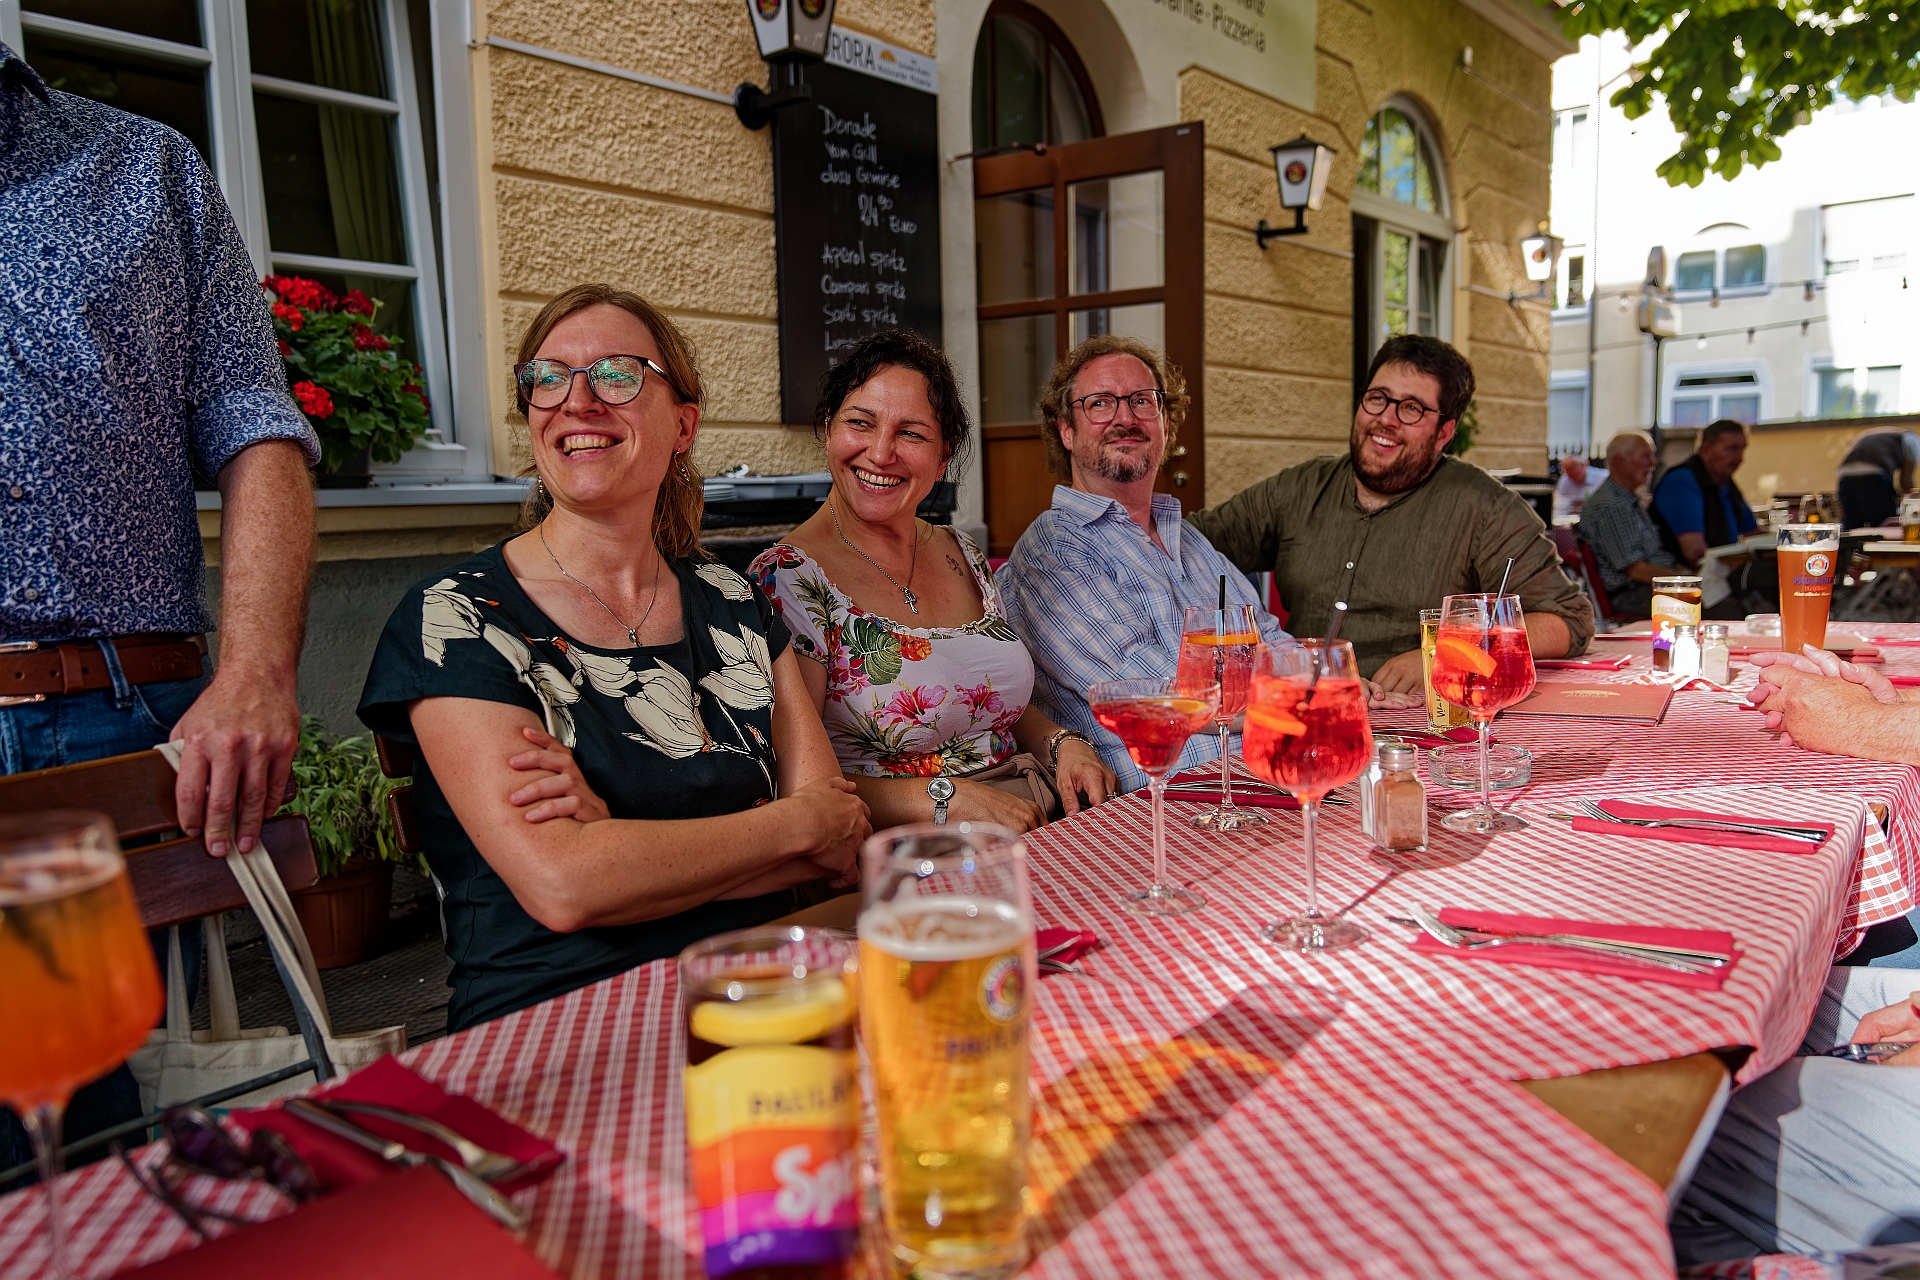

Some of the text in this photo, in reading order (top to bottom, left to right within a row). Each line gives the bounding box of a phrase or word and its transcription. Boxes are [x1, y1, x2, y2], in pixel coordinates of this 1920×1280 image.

[1212, 3, 1266, 53] Pizzeria
[827, 32, 876, 71] RORA
[817, 104, 877, 139] Dorade
[822, 240, 866, 269] Aperol
